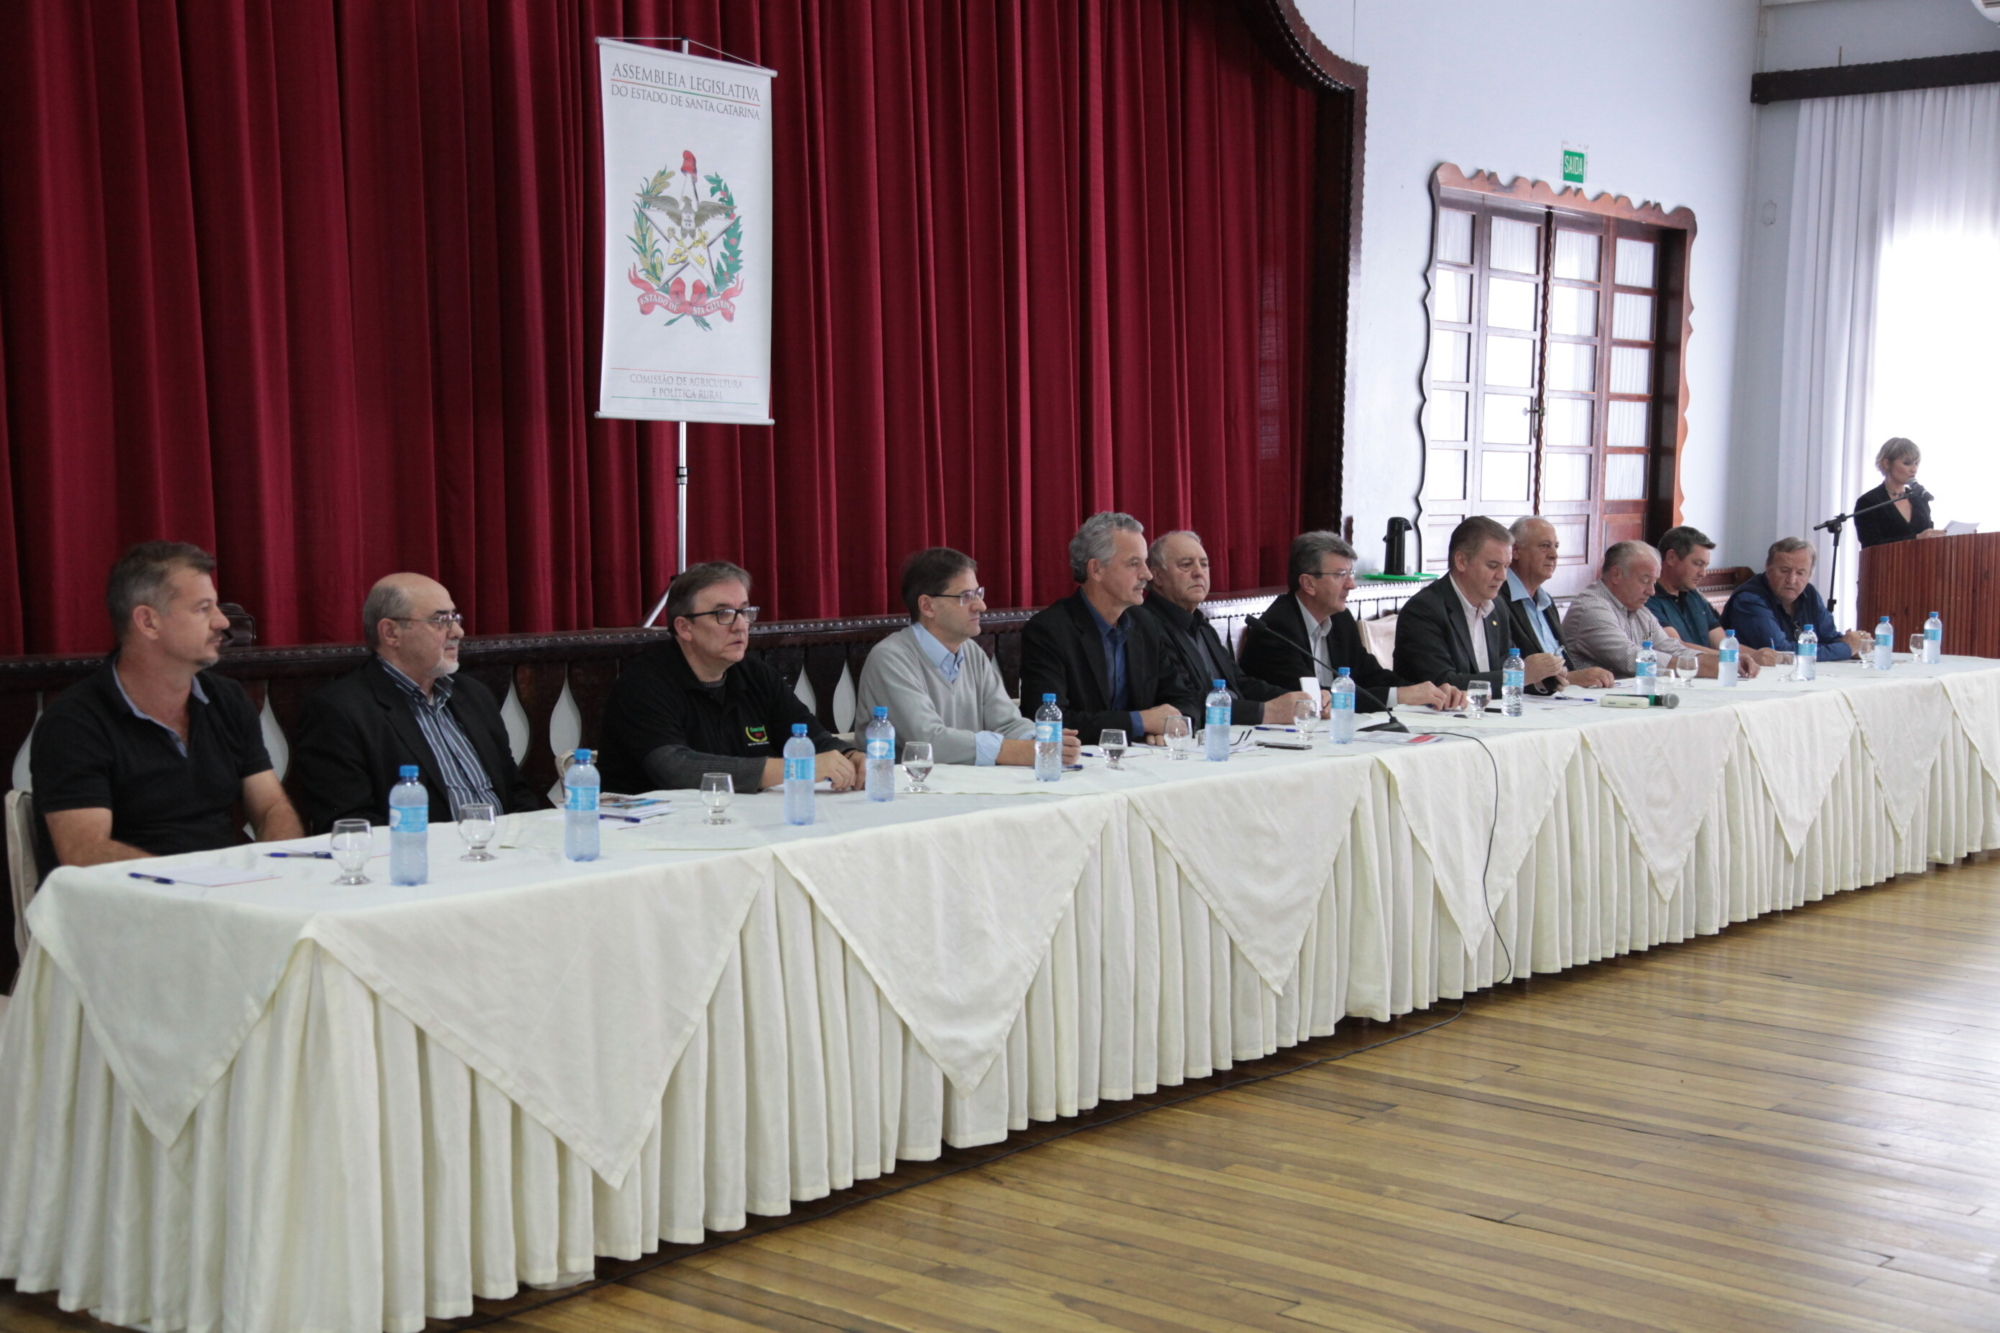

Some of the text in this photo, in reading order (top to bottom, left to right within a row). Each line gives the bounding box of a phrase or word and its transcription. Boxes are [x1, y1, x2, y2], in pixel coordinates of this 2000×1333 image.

[612, 63, 760, 102] ASSEMBLEIA LEGISLATIVA
[611, 84, 760, 120] DO ESTADO DE SANTA CATARINA
[640, 294, 679, 312] ESTADO DE
[692, 306, 705, 315] STA
[630, 374, 743, 390] COMISSÃO DE AGRICULTURA
[652, 387, 724, 400] E POLÍTICA RURAL
